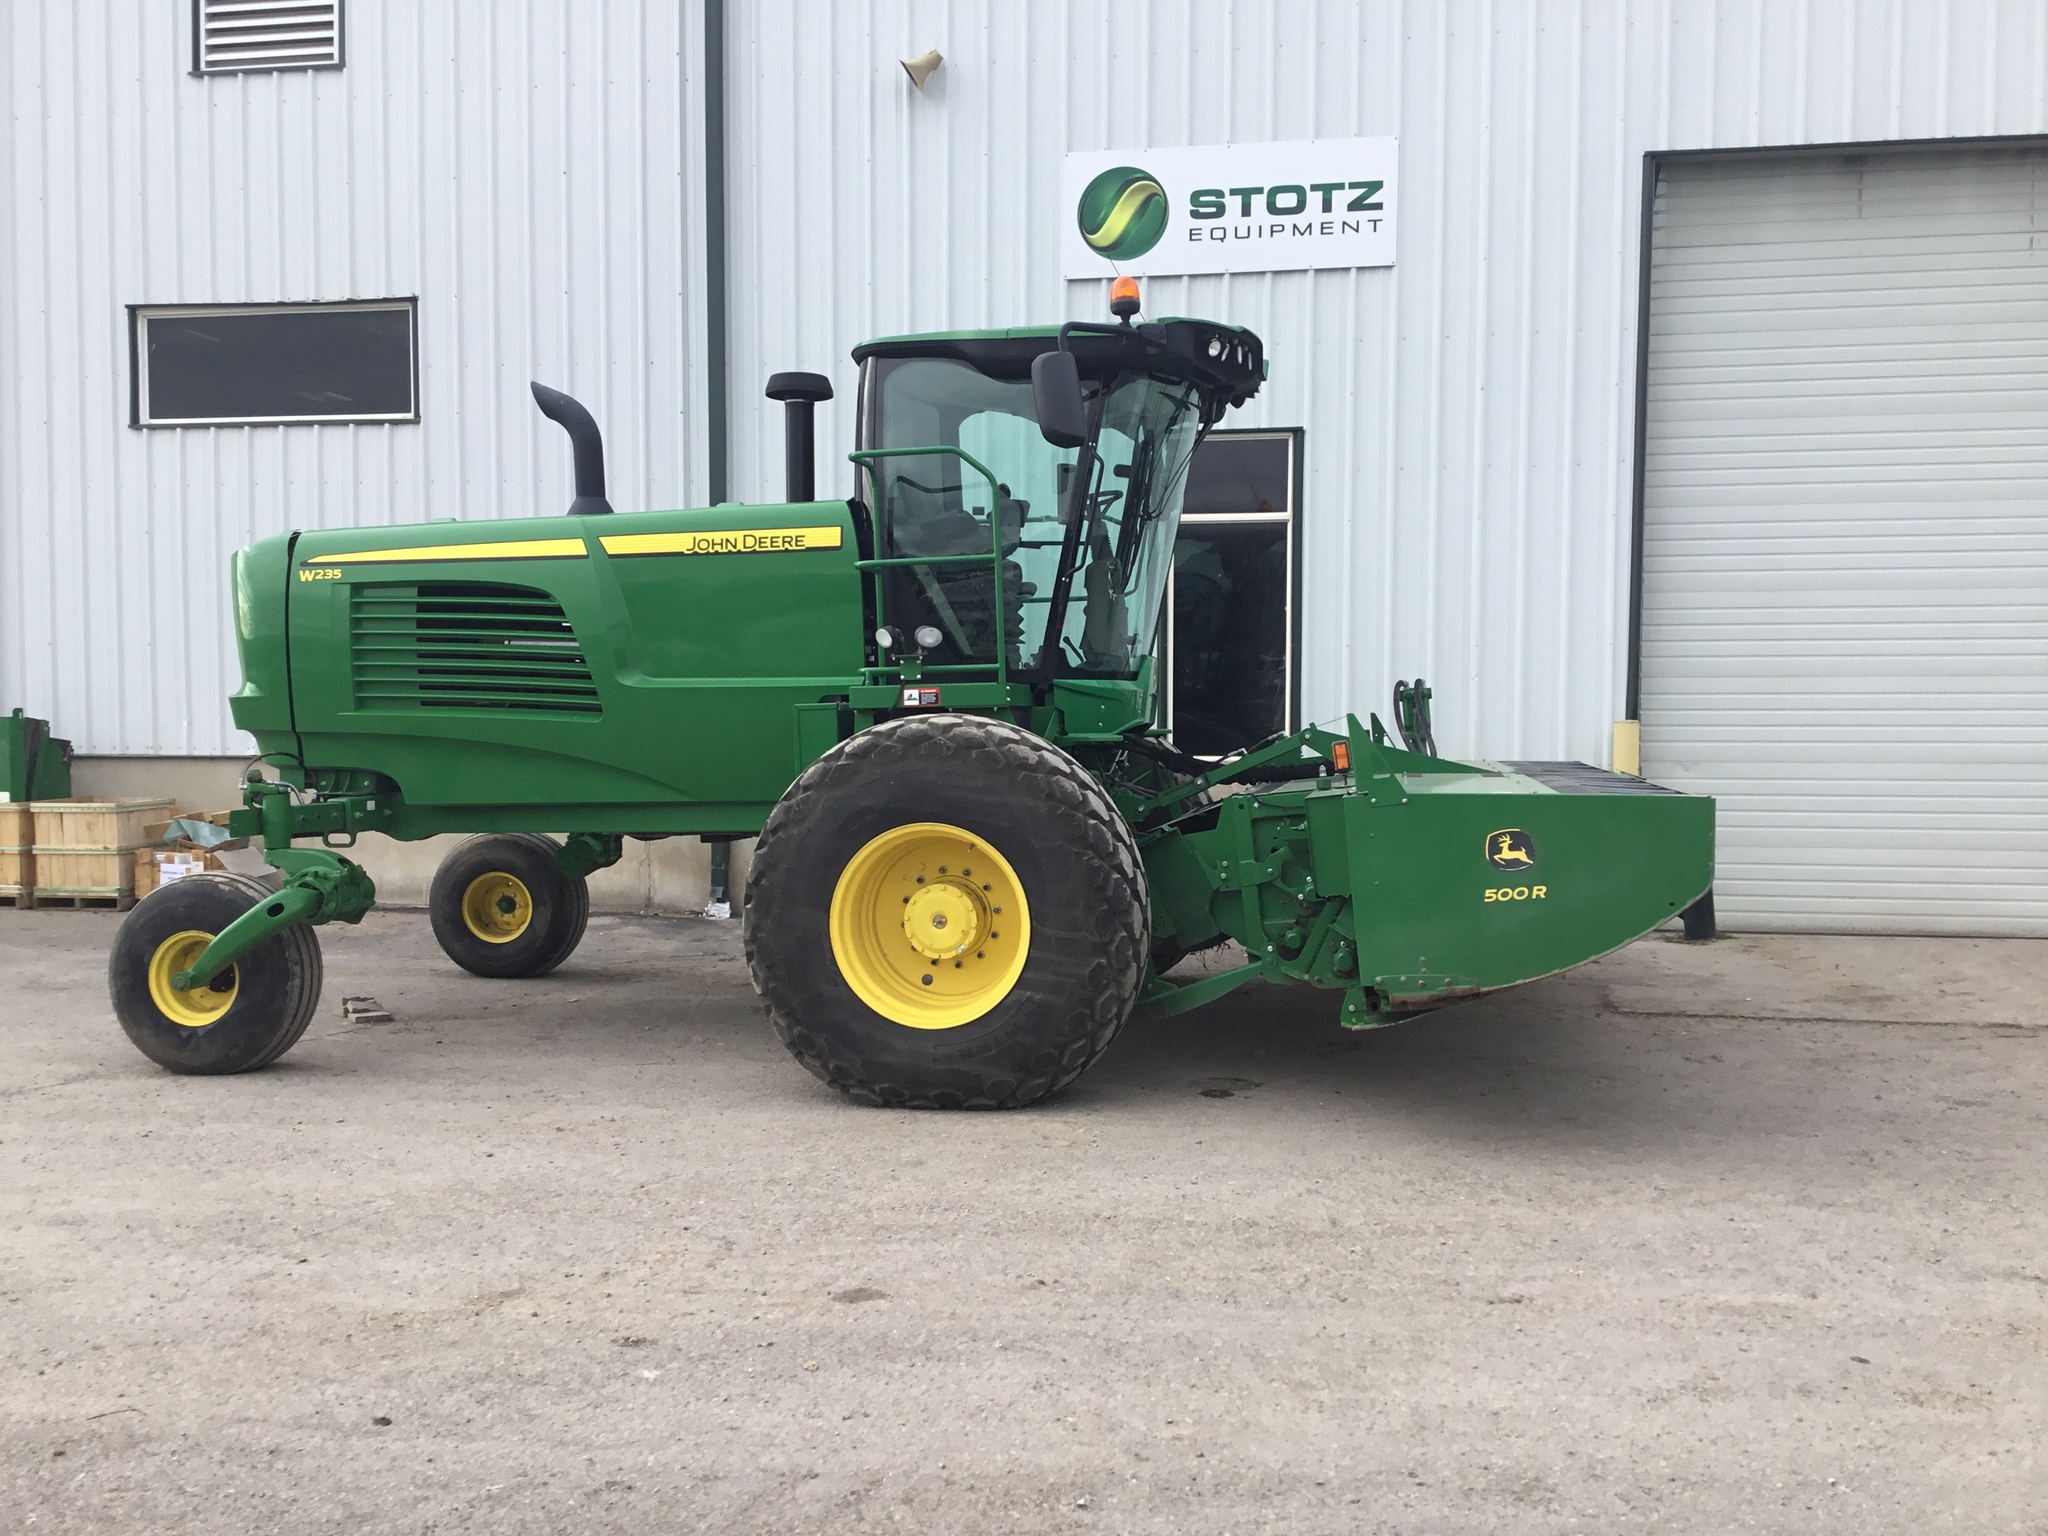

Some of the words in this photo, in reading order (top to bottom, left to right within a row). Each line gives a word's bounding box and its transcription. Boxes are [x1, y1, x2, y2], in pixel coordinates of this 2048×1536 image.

[1189, 180, 1384, 220] STOTZ
[1189, 219, 1384, 243] EQUIPMENT
[686, 536, 738, 552] JOHN
[743, 534, 806, 550] DEERE
[299, 569, 342, 582] W235
